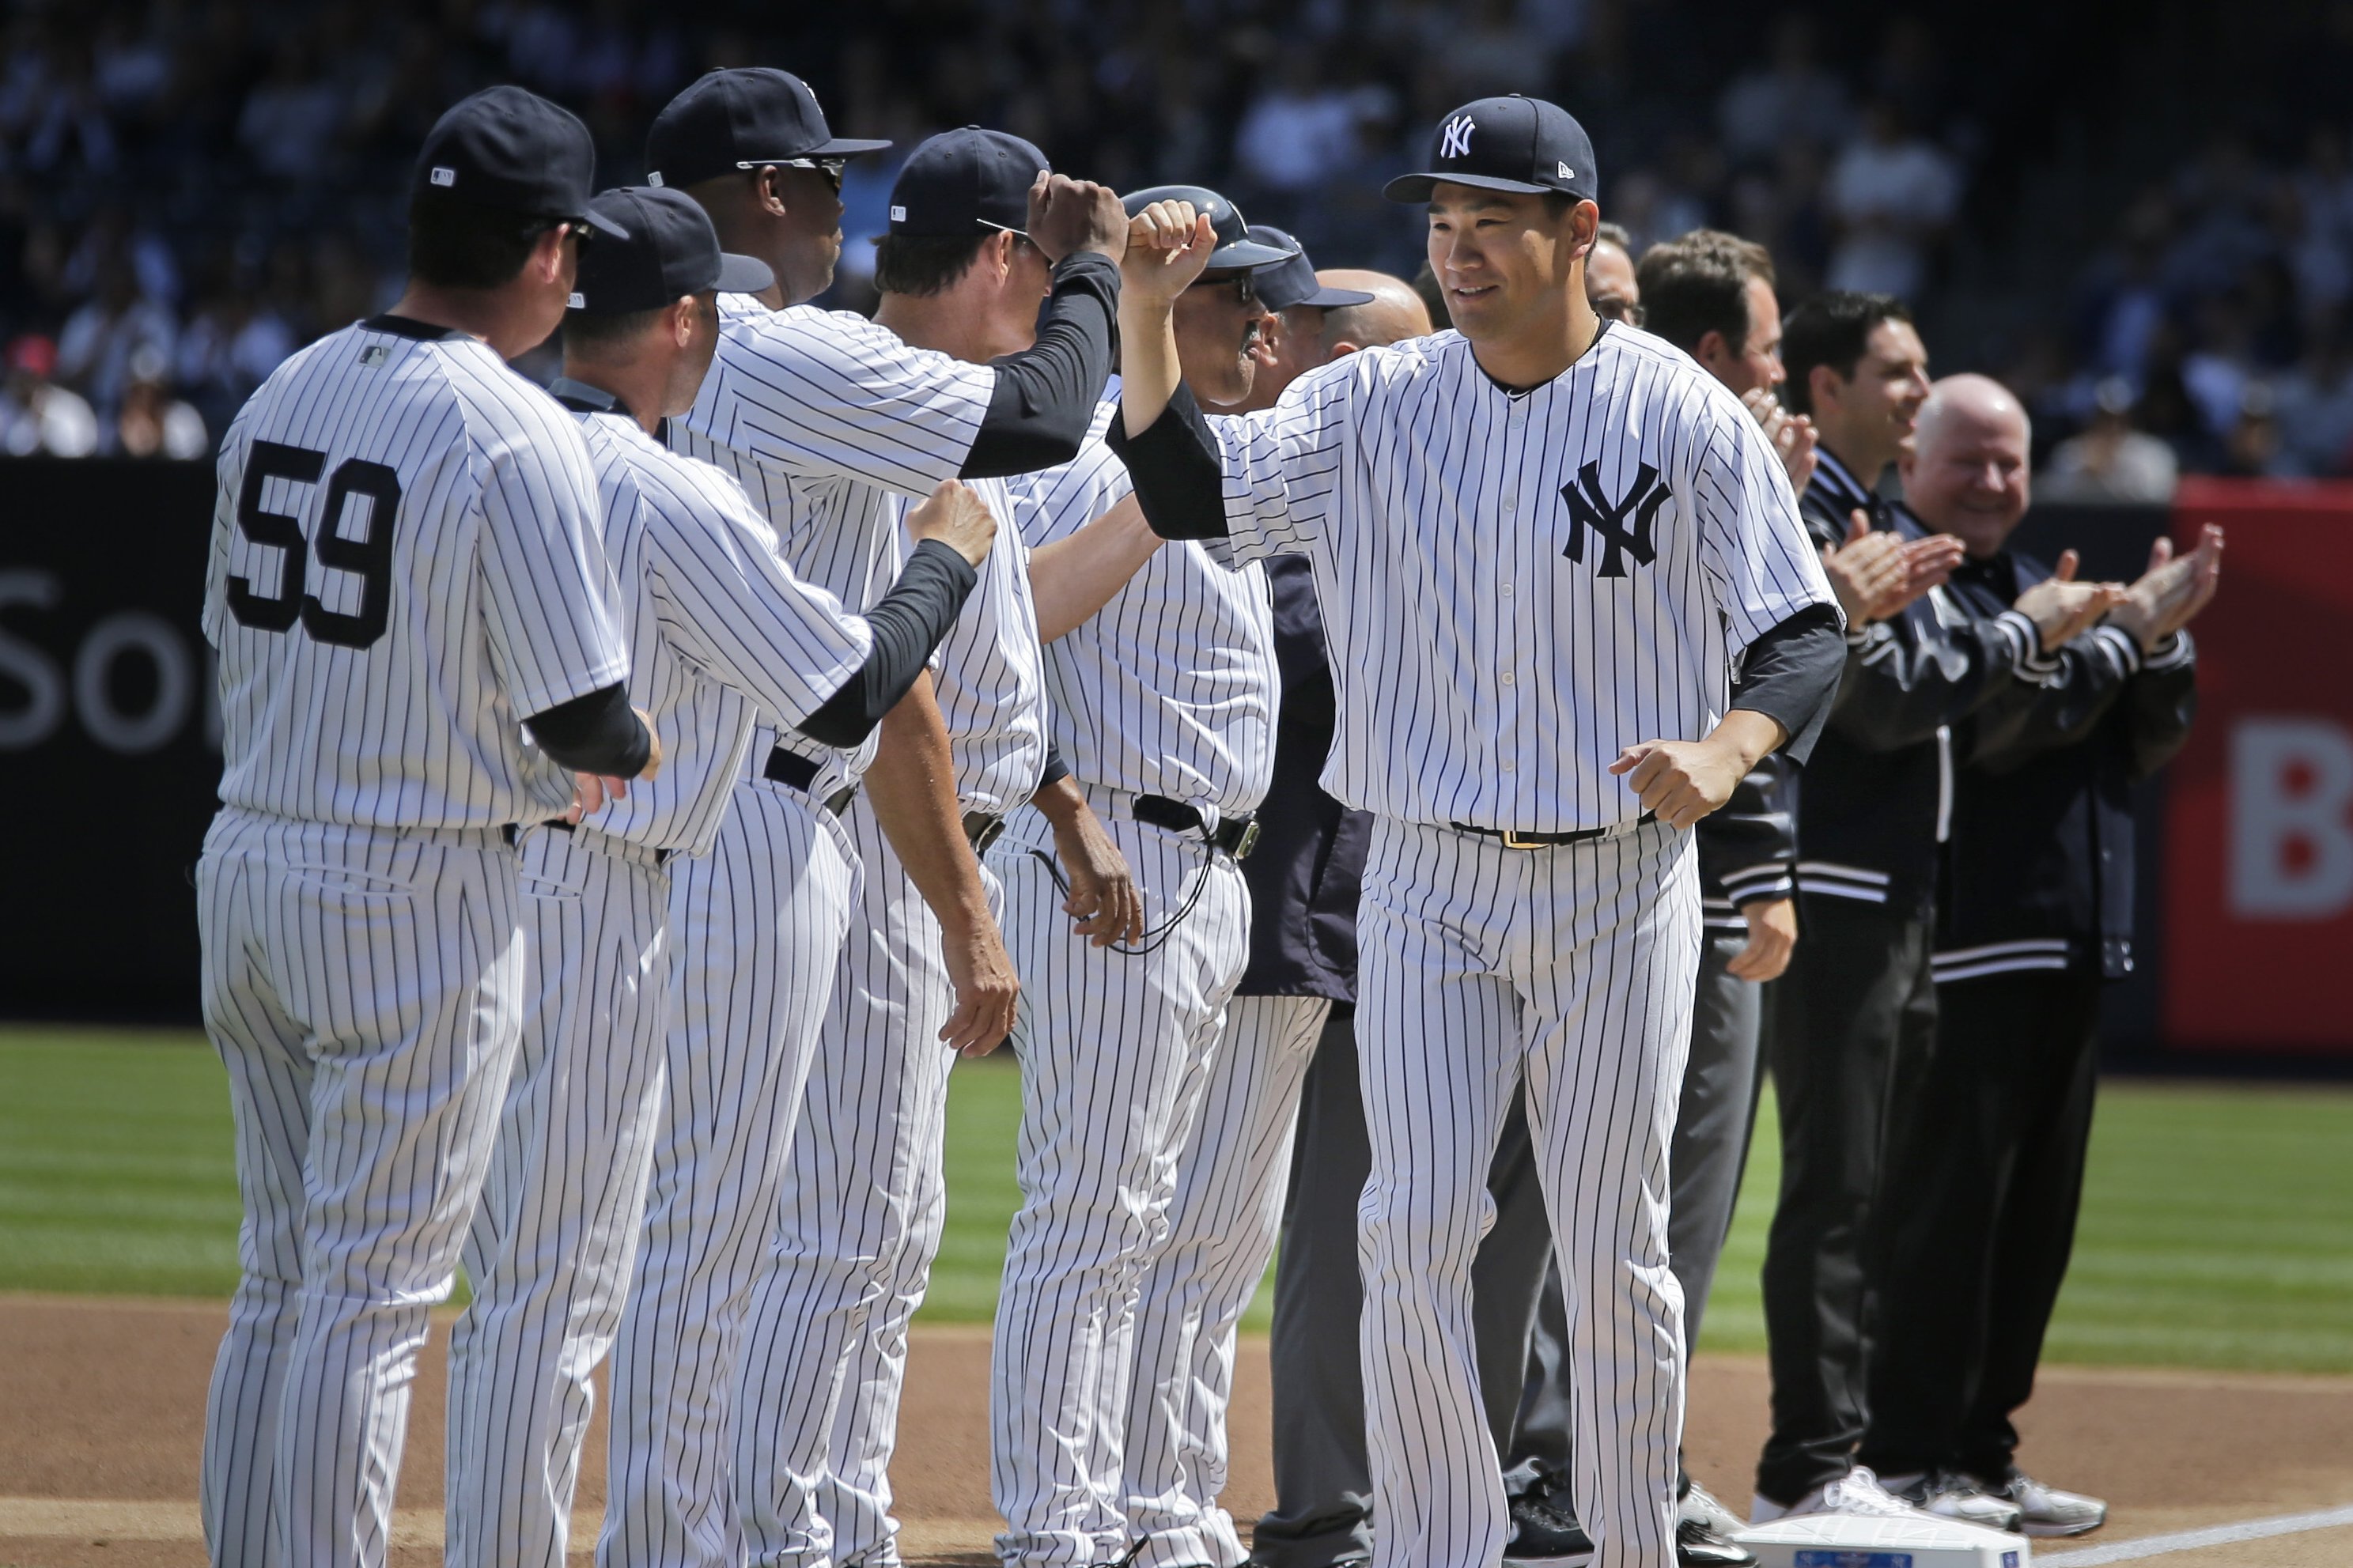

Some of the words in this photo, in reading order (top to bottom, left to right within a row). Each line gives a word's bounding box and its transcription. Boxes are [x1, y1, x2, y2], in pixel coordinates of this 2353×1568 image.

[1440, 115, 1476, 158] NY
[226, 438, 402, 651] 59
[1559, 459, 1673, 578] NY
[0, 570, 223, 751] So
